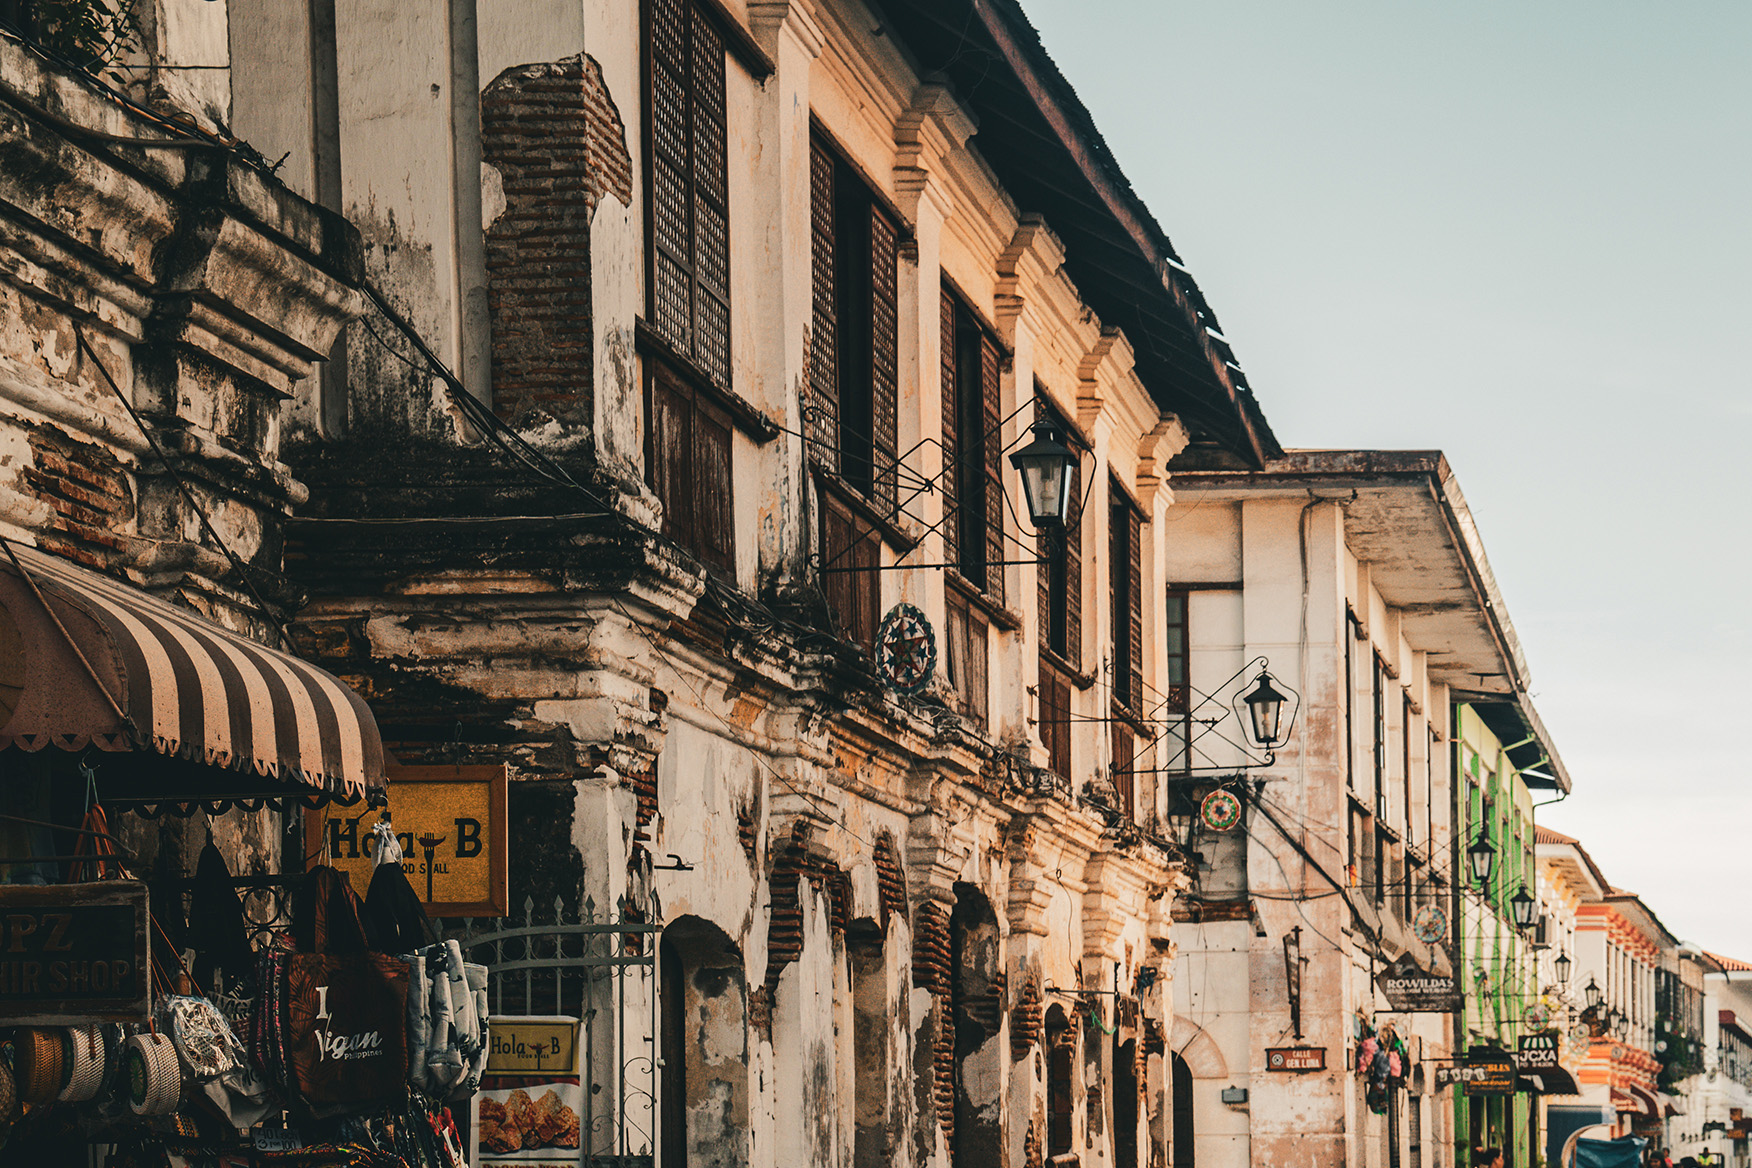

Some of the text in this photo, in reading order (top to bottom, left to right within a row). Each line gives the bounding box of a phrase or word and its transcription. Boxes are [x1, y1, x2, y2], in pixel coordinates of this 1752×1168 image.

[328, 818, 483, 859] Hoa B
[419, 863, 449, 874] SALL
[0, 913, 74, 953] PZ
[48, 960, 130, 993] SHOP
[1386, 978, 1455, 989] ROWILDA'S
[315, 985, 329, 1020] I
[314, 1012, 383, 1062] Vigan
[490, 1033, 561, 1054] Hola B
[1292, 1050, 1311, 1058] CALLE
[1301, 1058, 1320, 1068] LUNA
[1520, 1049, 1557, 1062] JCXA
